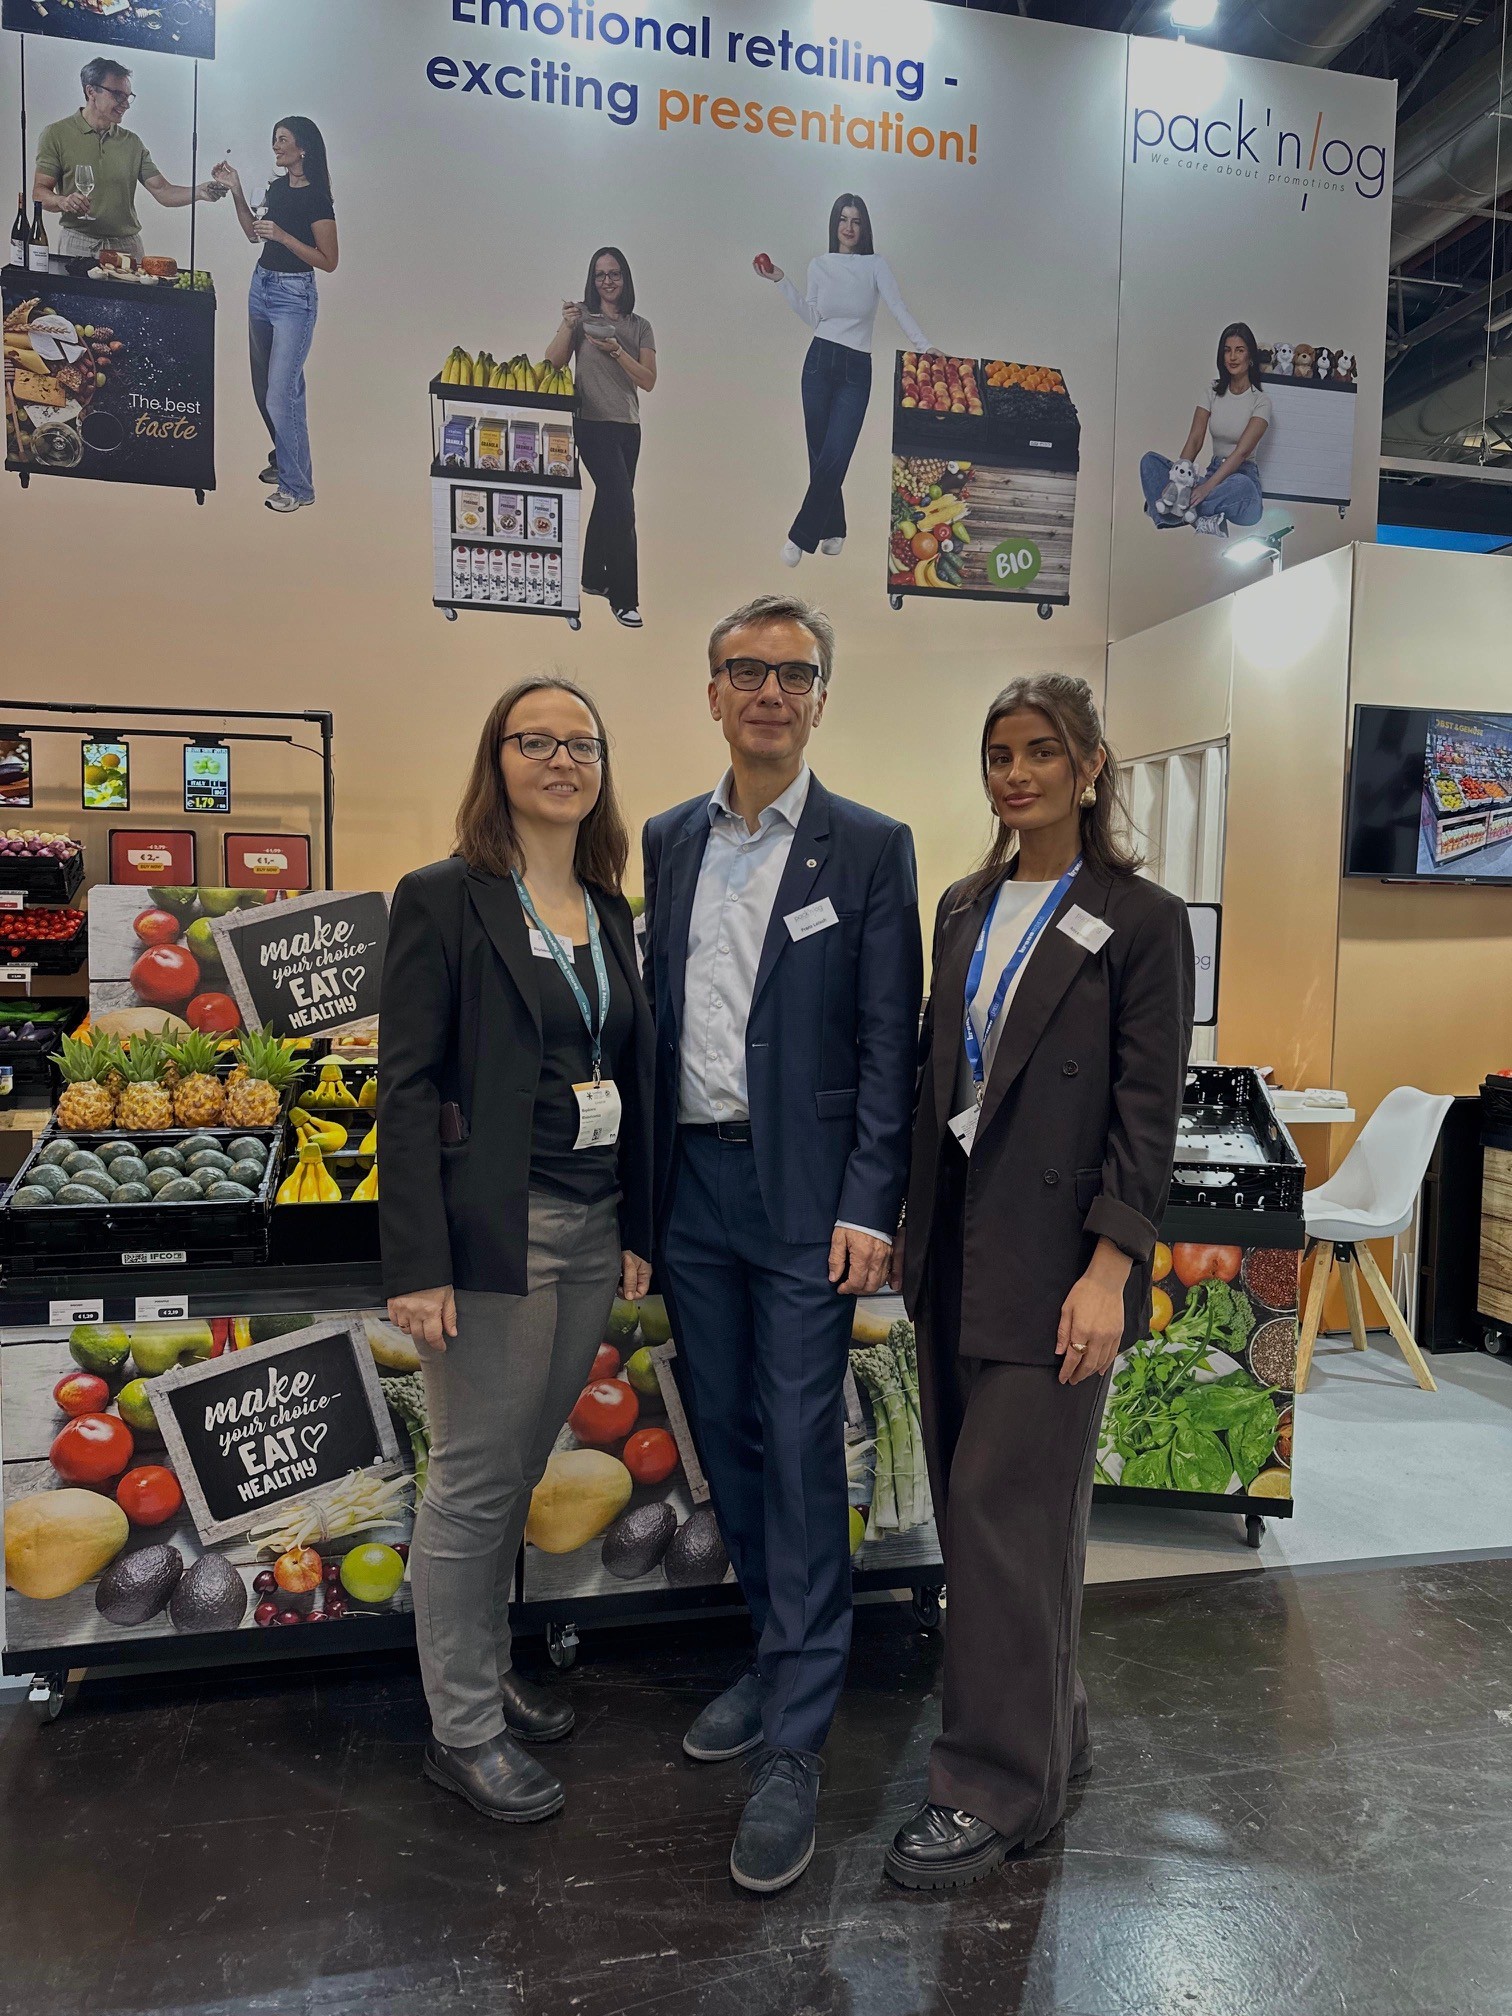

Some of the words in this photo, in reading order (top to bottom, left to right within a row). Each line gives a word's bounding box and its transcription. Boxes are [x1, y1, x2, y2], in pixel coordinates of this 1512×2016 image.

[452, 0, 710, 58] Emotional
[728, 29, 924, 101] retailing
[427, 56, 638, 126] exciting
[659, 88, 978, 165] presentation!
[1151, 152, 1169, 165] We
[1177, 158, 1209, 172] care
[1216, 164, 1259, 179] about
[1268, 172, 1346, 192] promotions
[129, 393, 160, 410] The
[165, 397, 201, 414] best
[135, 412, 198, 440] taste
[996, 549, 1033, 579] BIO
[195, 797, 215, 809] 1,79
[260, 915, 355, 967] make
[272, 956, 314, 989] your
[288, 967, 341, 1008] EAT
[288, 994, 357, 1029] HEALTHY
[150, 1252, 173, 1260] IFCO
[204, 1367, 316, 1431] make
[219, 1415, 267, 1457] your
[238, 1426, 299, 1476] EAT
[237, 1457, 317, 1503] HEALTHY
